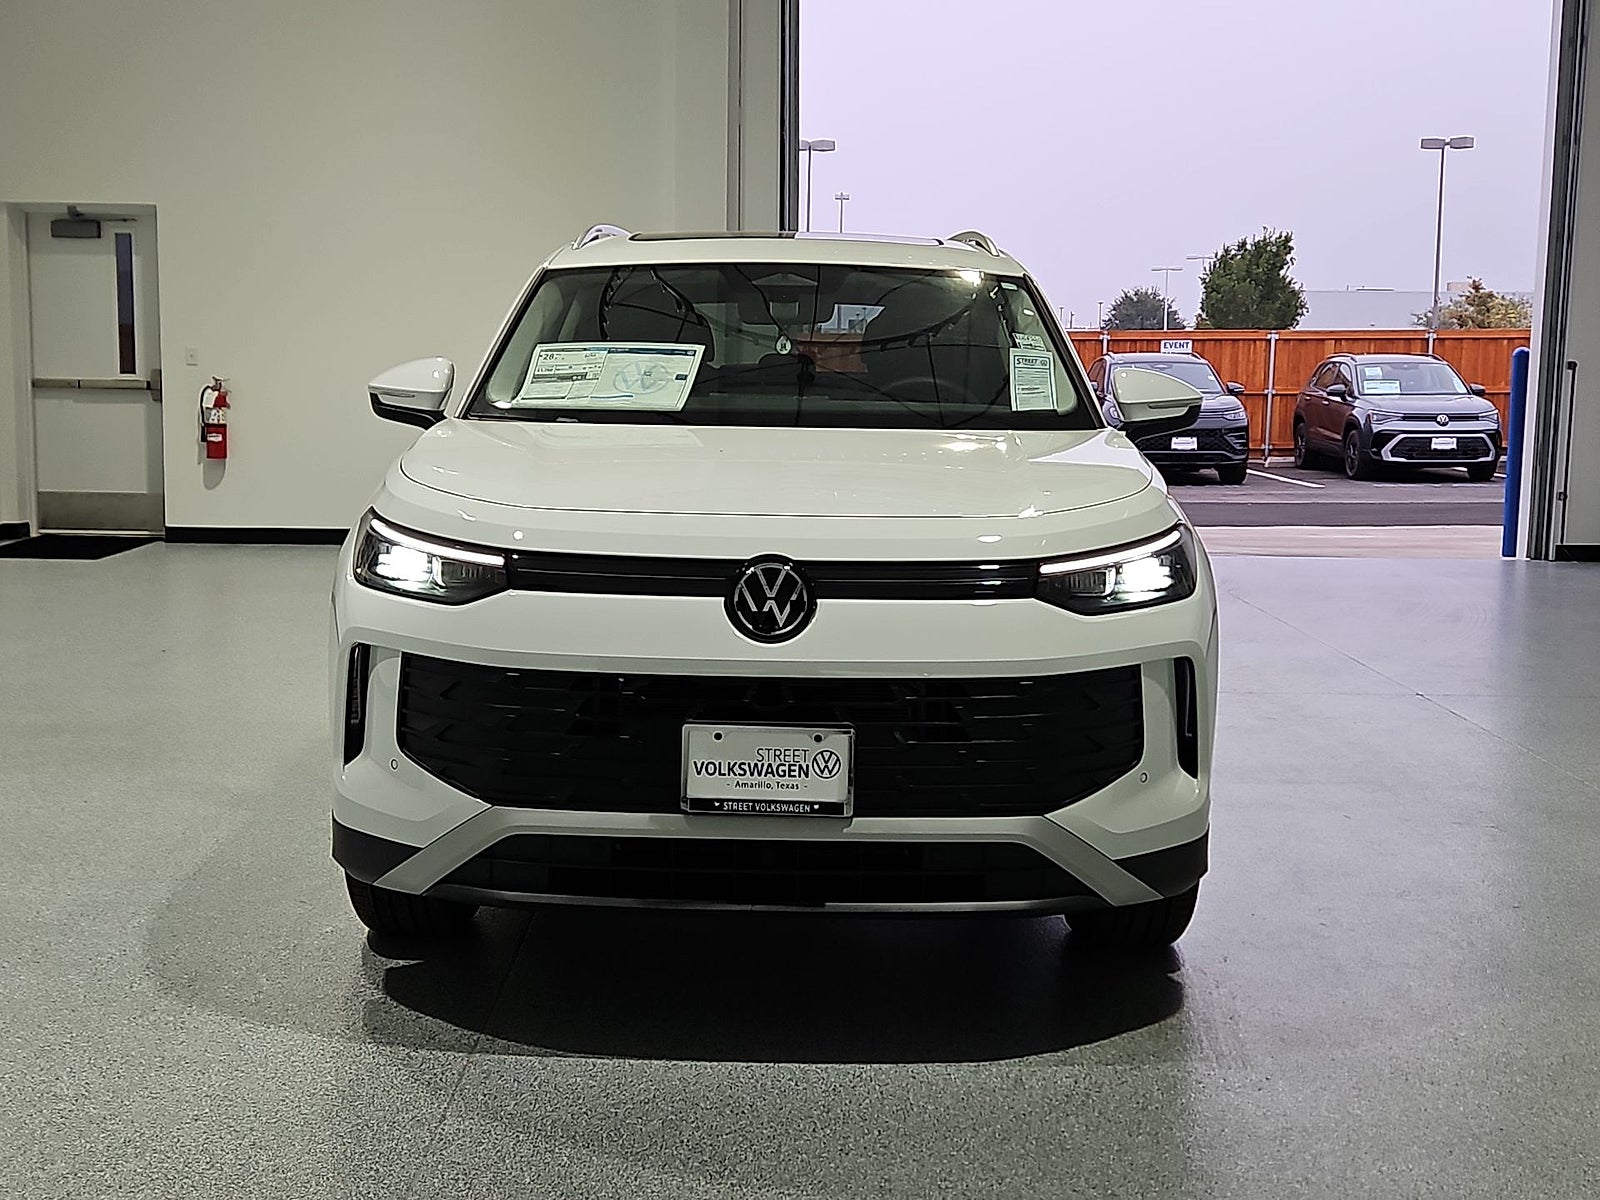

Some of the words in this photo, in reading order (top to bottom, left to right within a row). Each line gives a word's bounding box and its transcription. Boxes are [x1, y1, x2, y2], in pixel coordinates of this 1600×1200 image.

[1163, 341, 1190, 349] EVENT
[756, 748, 810, 763] STREET
[693, 761, 810, 778] VOLKSWAGEN
[734, 780, 774, 790] Amarillo,
[775, 781, 800, 790] Texas
[723, 801, 752, 811] STREET
[754, 802, 811, 813] VOLKSWAGEN
